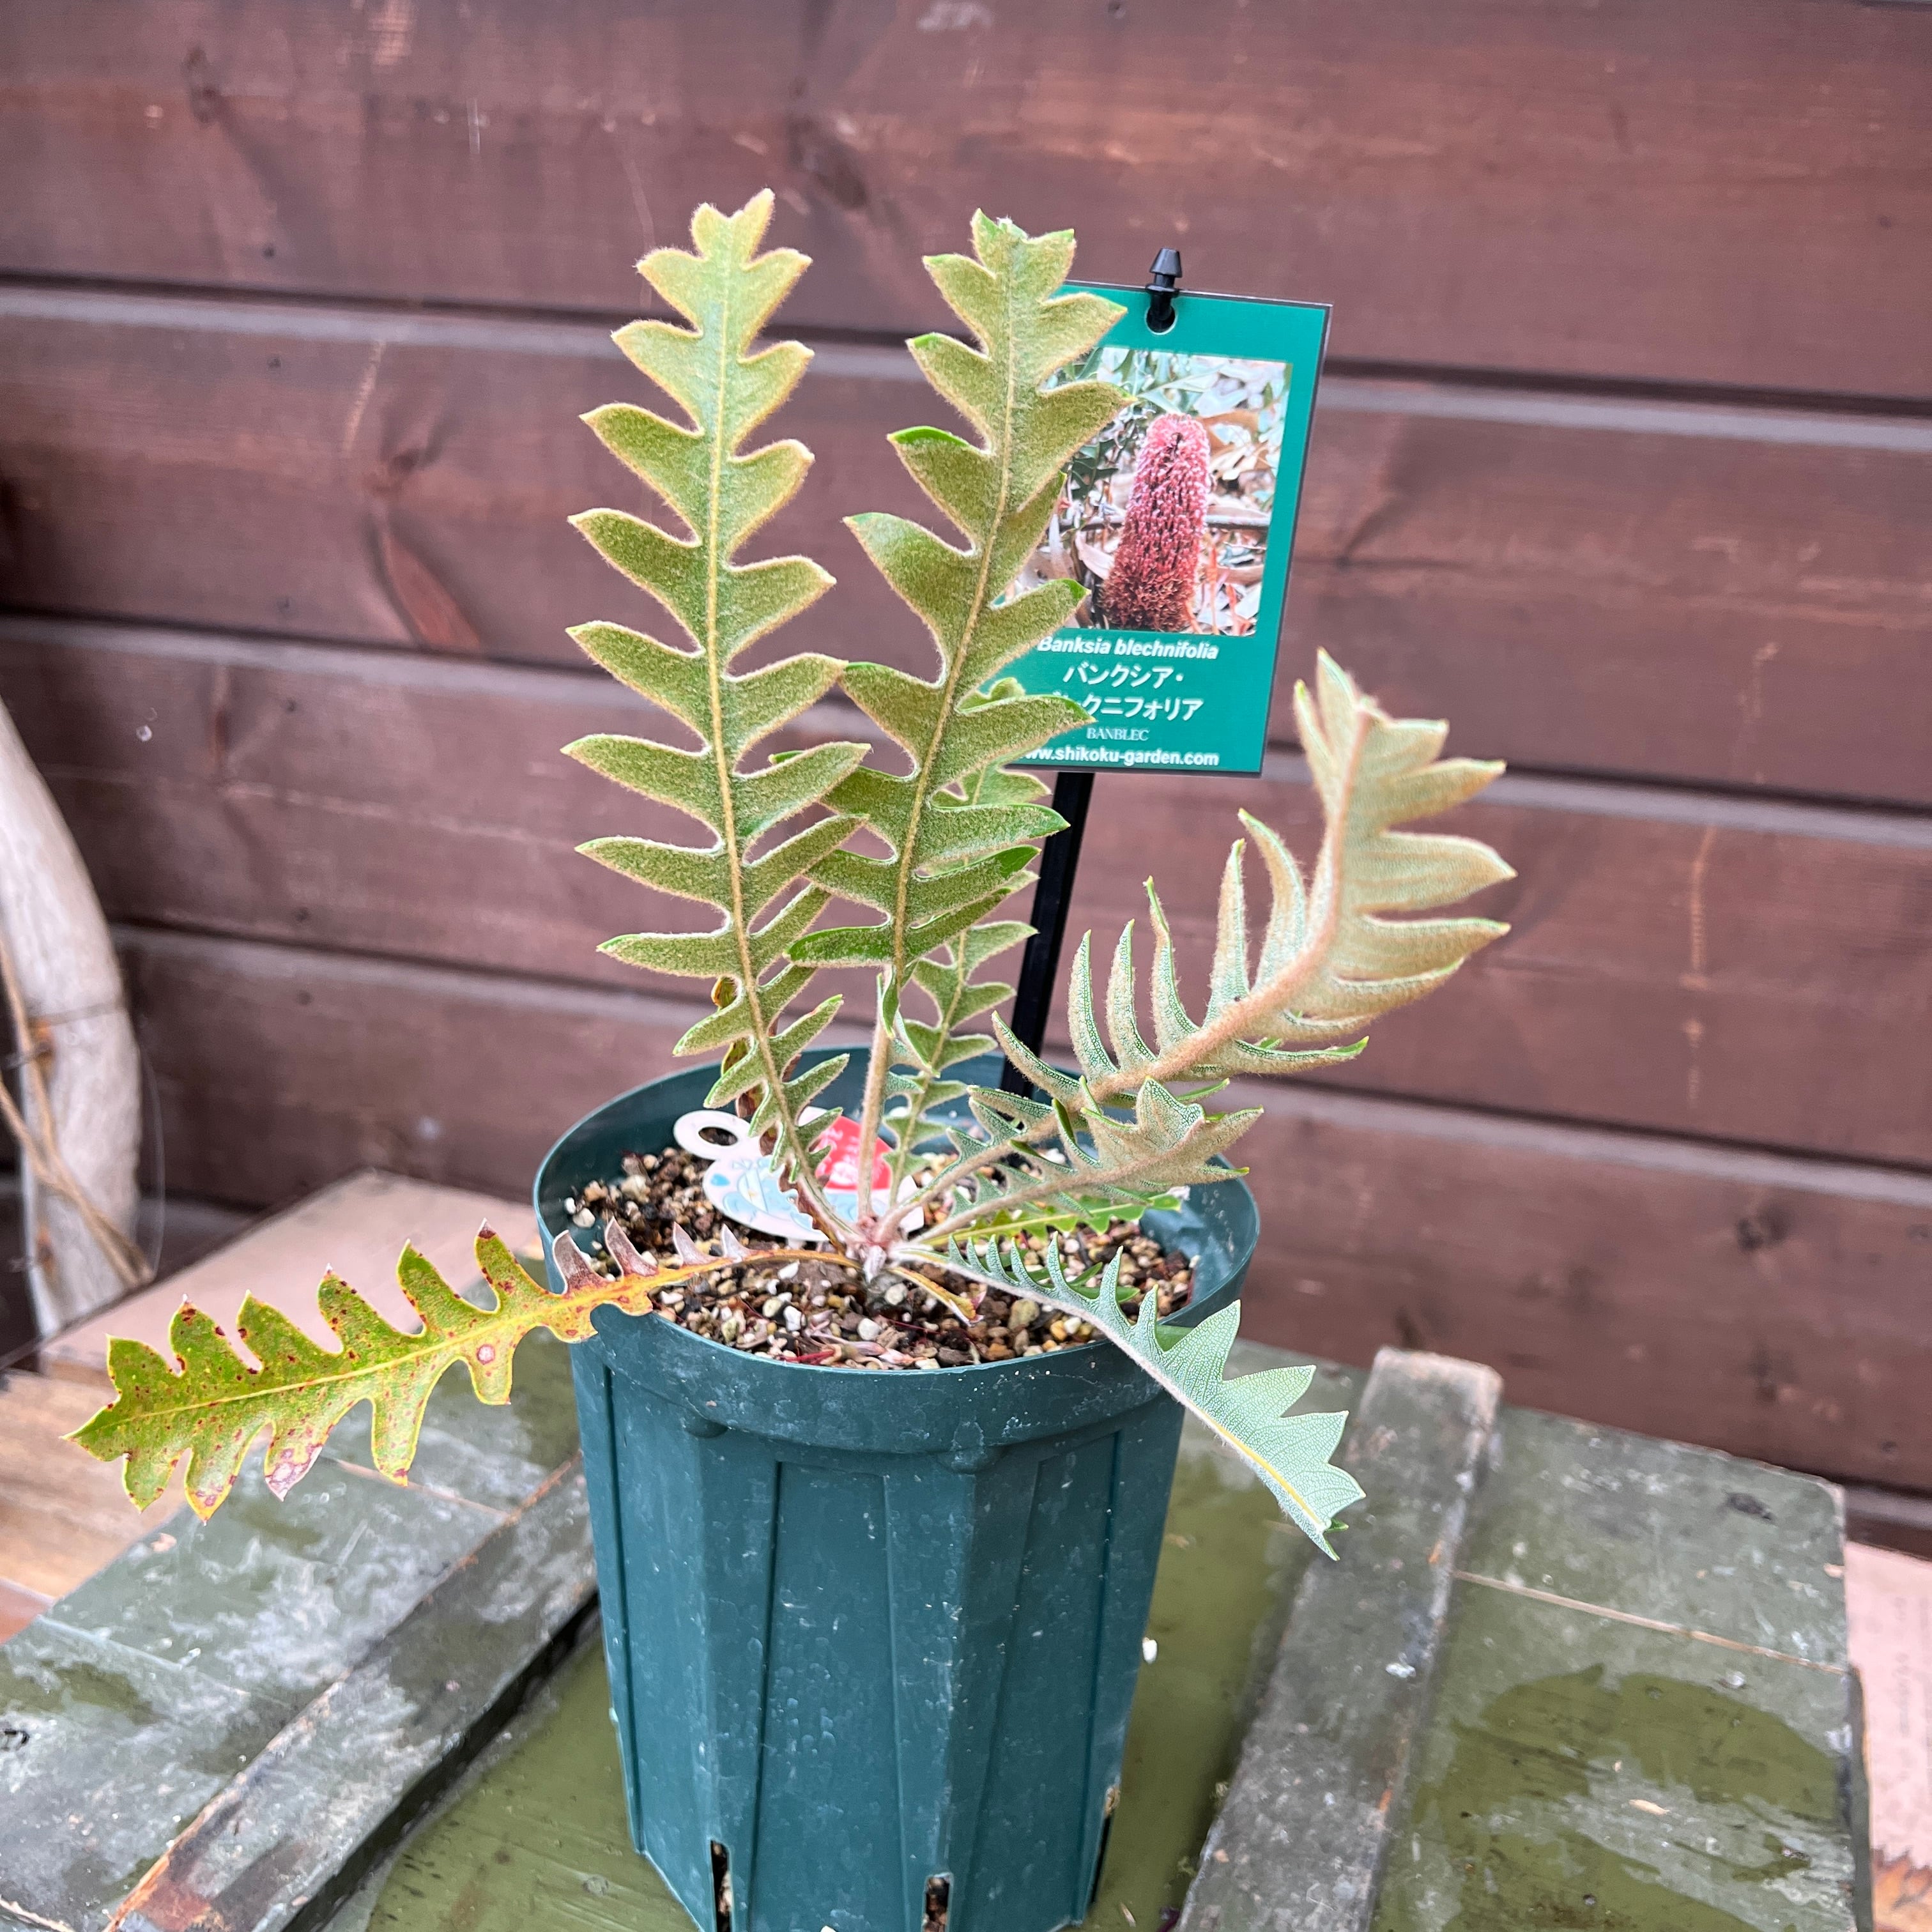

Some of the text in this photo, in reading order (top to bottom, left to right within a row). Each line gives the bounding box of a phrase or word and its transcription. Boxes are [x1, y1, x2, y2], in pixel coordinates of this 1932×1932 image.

[1038, 636, 1219, 659] Banksia blechnifolia
[1053, 692, 1204, 721] クニフォリア
[1087, 727, 1149, 742] BANBLEC
[1021, 746, 1219, 766] ww.shikoku-garden.com
